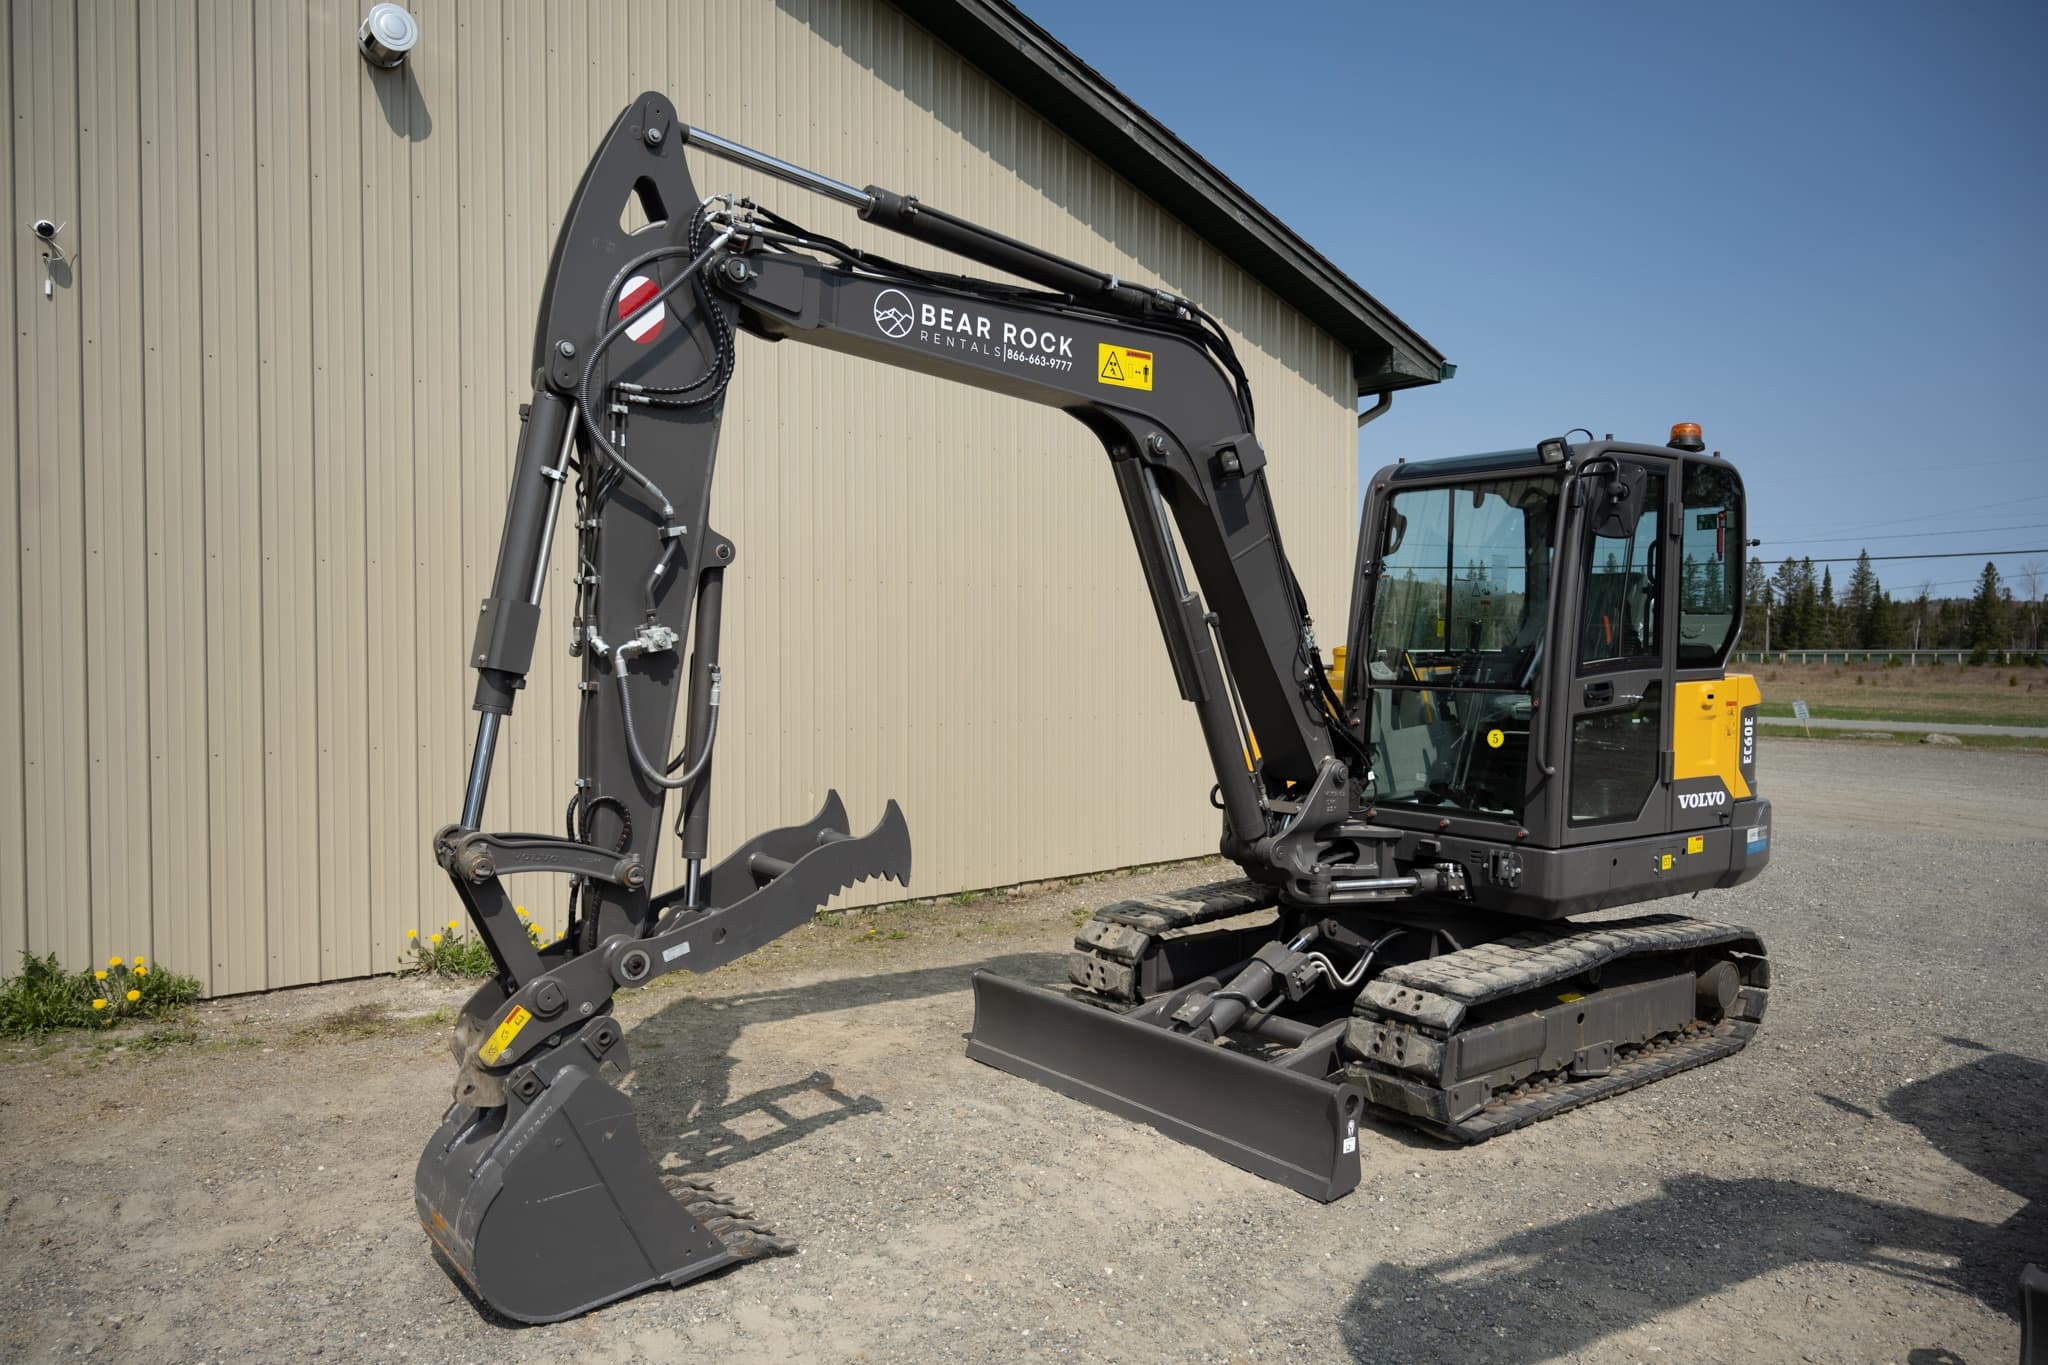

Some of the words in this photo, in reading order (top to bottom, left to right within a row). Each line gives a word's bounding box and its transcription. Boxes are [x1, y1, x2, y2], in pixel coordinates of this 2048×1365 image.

[920, 330, 1002, 357] RENTALS
[1007, 348, 1073, 372] 866-663-9777
[921, 303, 991, 339] BEAR
[1004, 322, 1073, 358] ROCK
[1492, 733, 1499, 744] 5
[1743, 716, 1754, 764] EC60E
[1678, 790, 1726, 808] VOLVO
